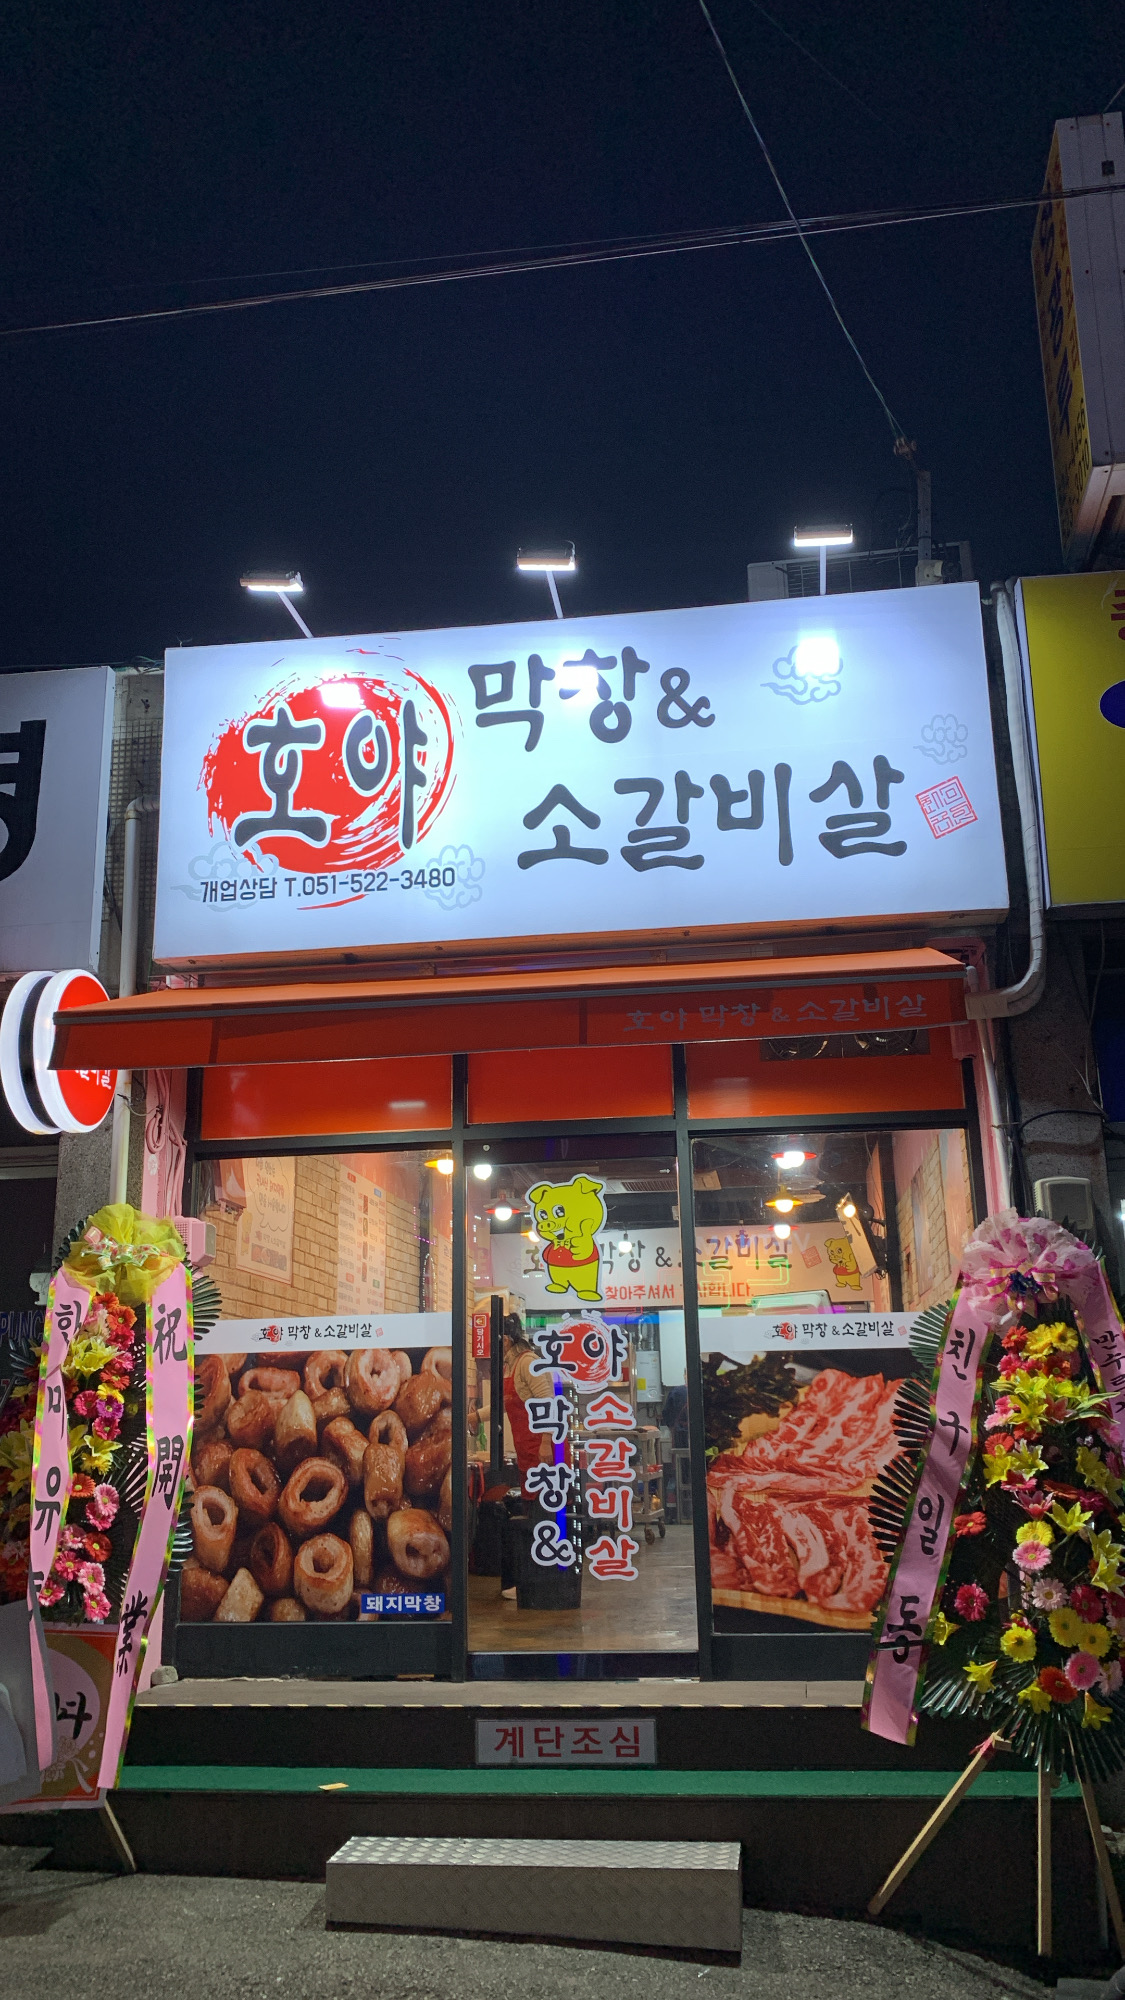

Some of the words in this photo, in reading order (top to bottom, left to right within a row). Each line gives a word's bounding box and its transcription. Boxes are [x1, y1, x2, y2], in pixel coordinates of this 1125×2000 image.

[235, 700, 428, 850] 호야
[517, 755, 908, 872] 소갈비살
[201, 877, 277, 903] 개업상담
[285, 867, 456, 897] T.051-522-3480
[624, 1009, 687, 1031] 호야
[700, 1003, 761, 1027] 막창
[605, 1283, 675, 1301] 찾아주셔서
[259, 1326, 284, 1341] 호야
[288, 1324, 311, 1341] 막창
[324, 1322, 373, 1340] 소갈비살
[476, 1328, 485, 1356] 당기시오
[772, 1323, 798, 1339] 호야
[802, 1322, 828, 1339] 막창
[842, 1320, 895, 1338] 소갈비살
[533, 1327, 626, 1378] 호야
[586, 1393, 637, 1578] 소갈비살
[366, 1595, 442, 1612] 돼지막창
[494, 1725, 641, 1758] 계단조심
